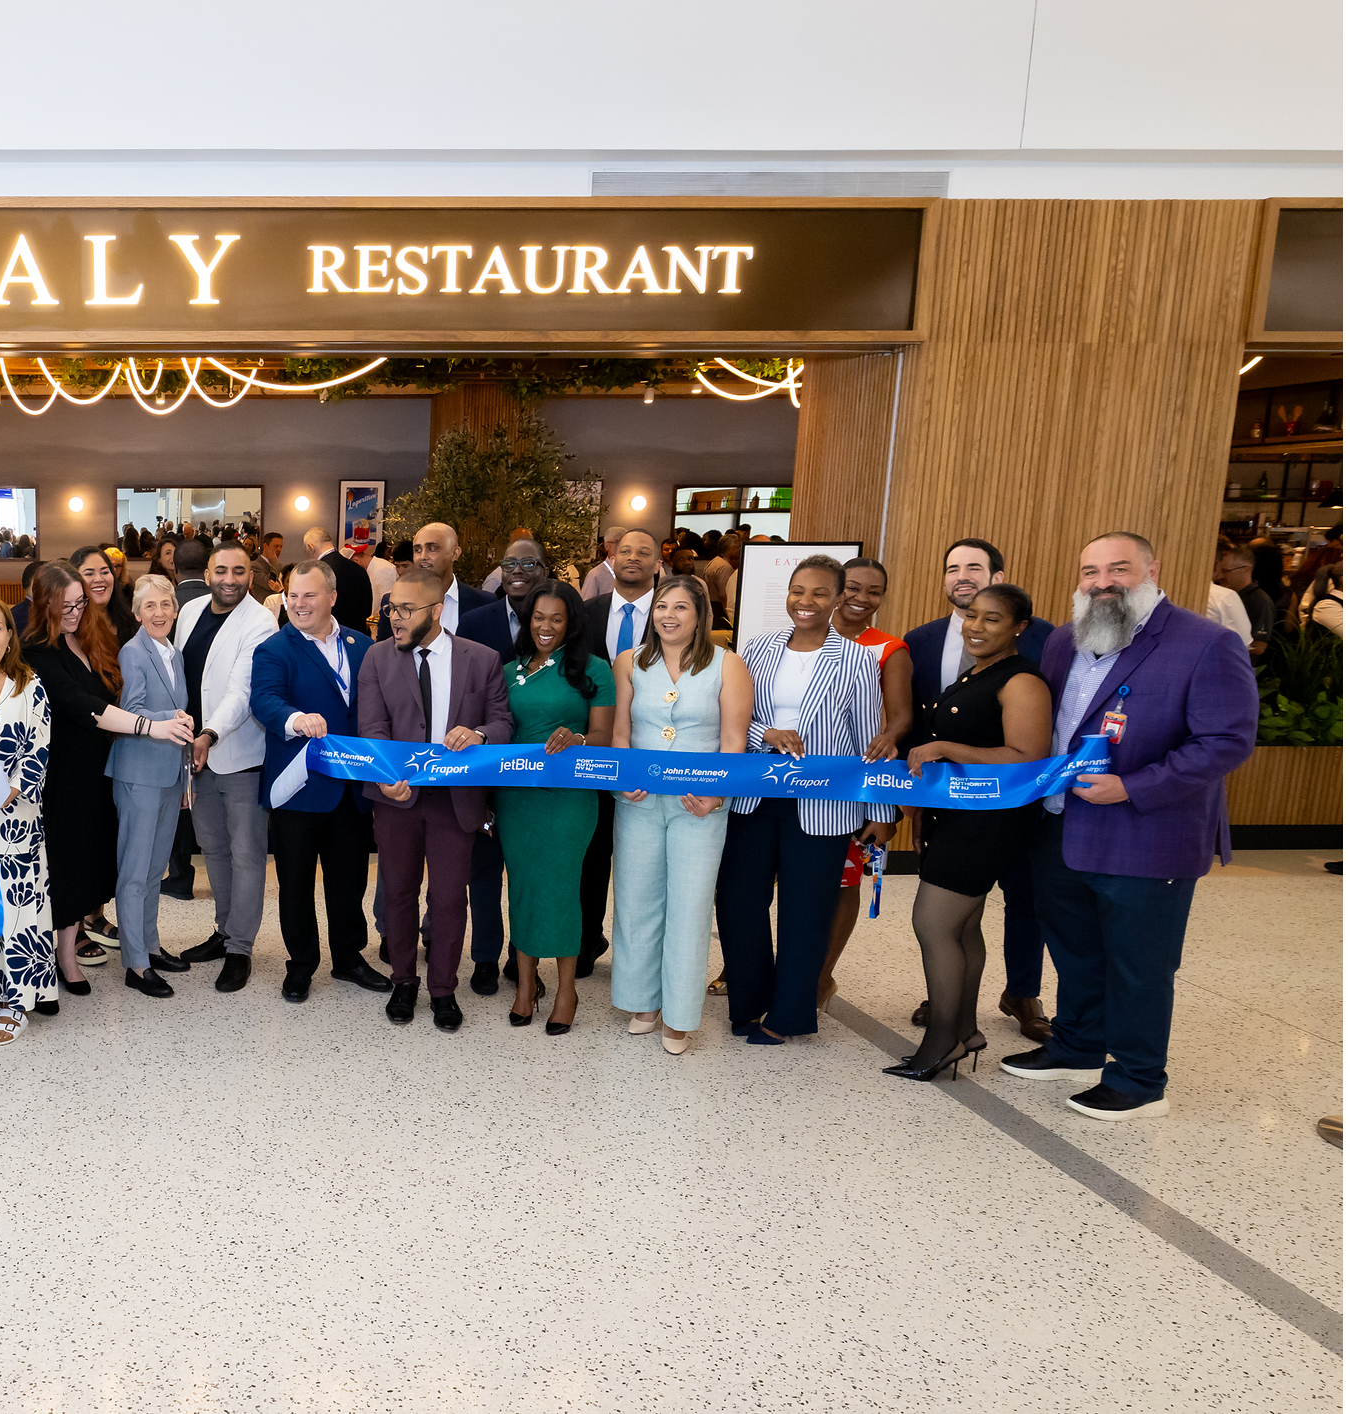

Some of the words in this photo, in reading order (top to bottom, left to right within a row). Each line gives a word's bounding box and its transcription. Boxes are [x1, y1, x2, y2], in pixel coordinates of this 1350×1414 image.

[306, 244, 754, 295] RESTAURANT
[775, 558, 799, 566] EAT
[319, 749, 333, 758] John
[340, 752, 375, 764] Kennedy
[431, 764, 469, 775] Fraport
[499, 758, 544, 773] jetBlue
[662, 774, 699, 782] International
[663, 767, 684, 775] John
[691, 769, 729, 779] Kennedy
[790, 776, 830, 789] Fraport
[862, 772, 913, 790] jetBlue
